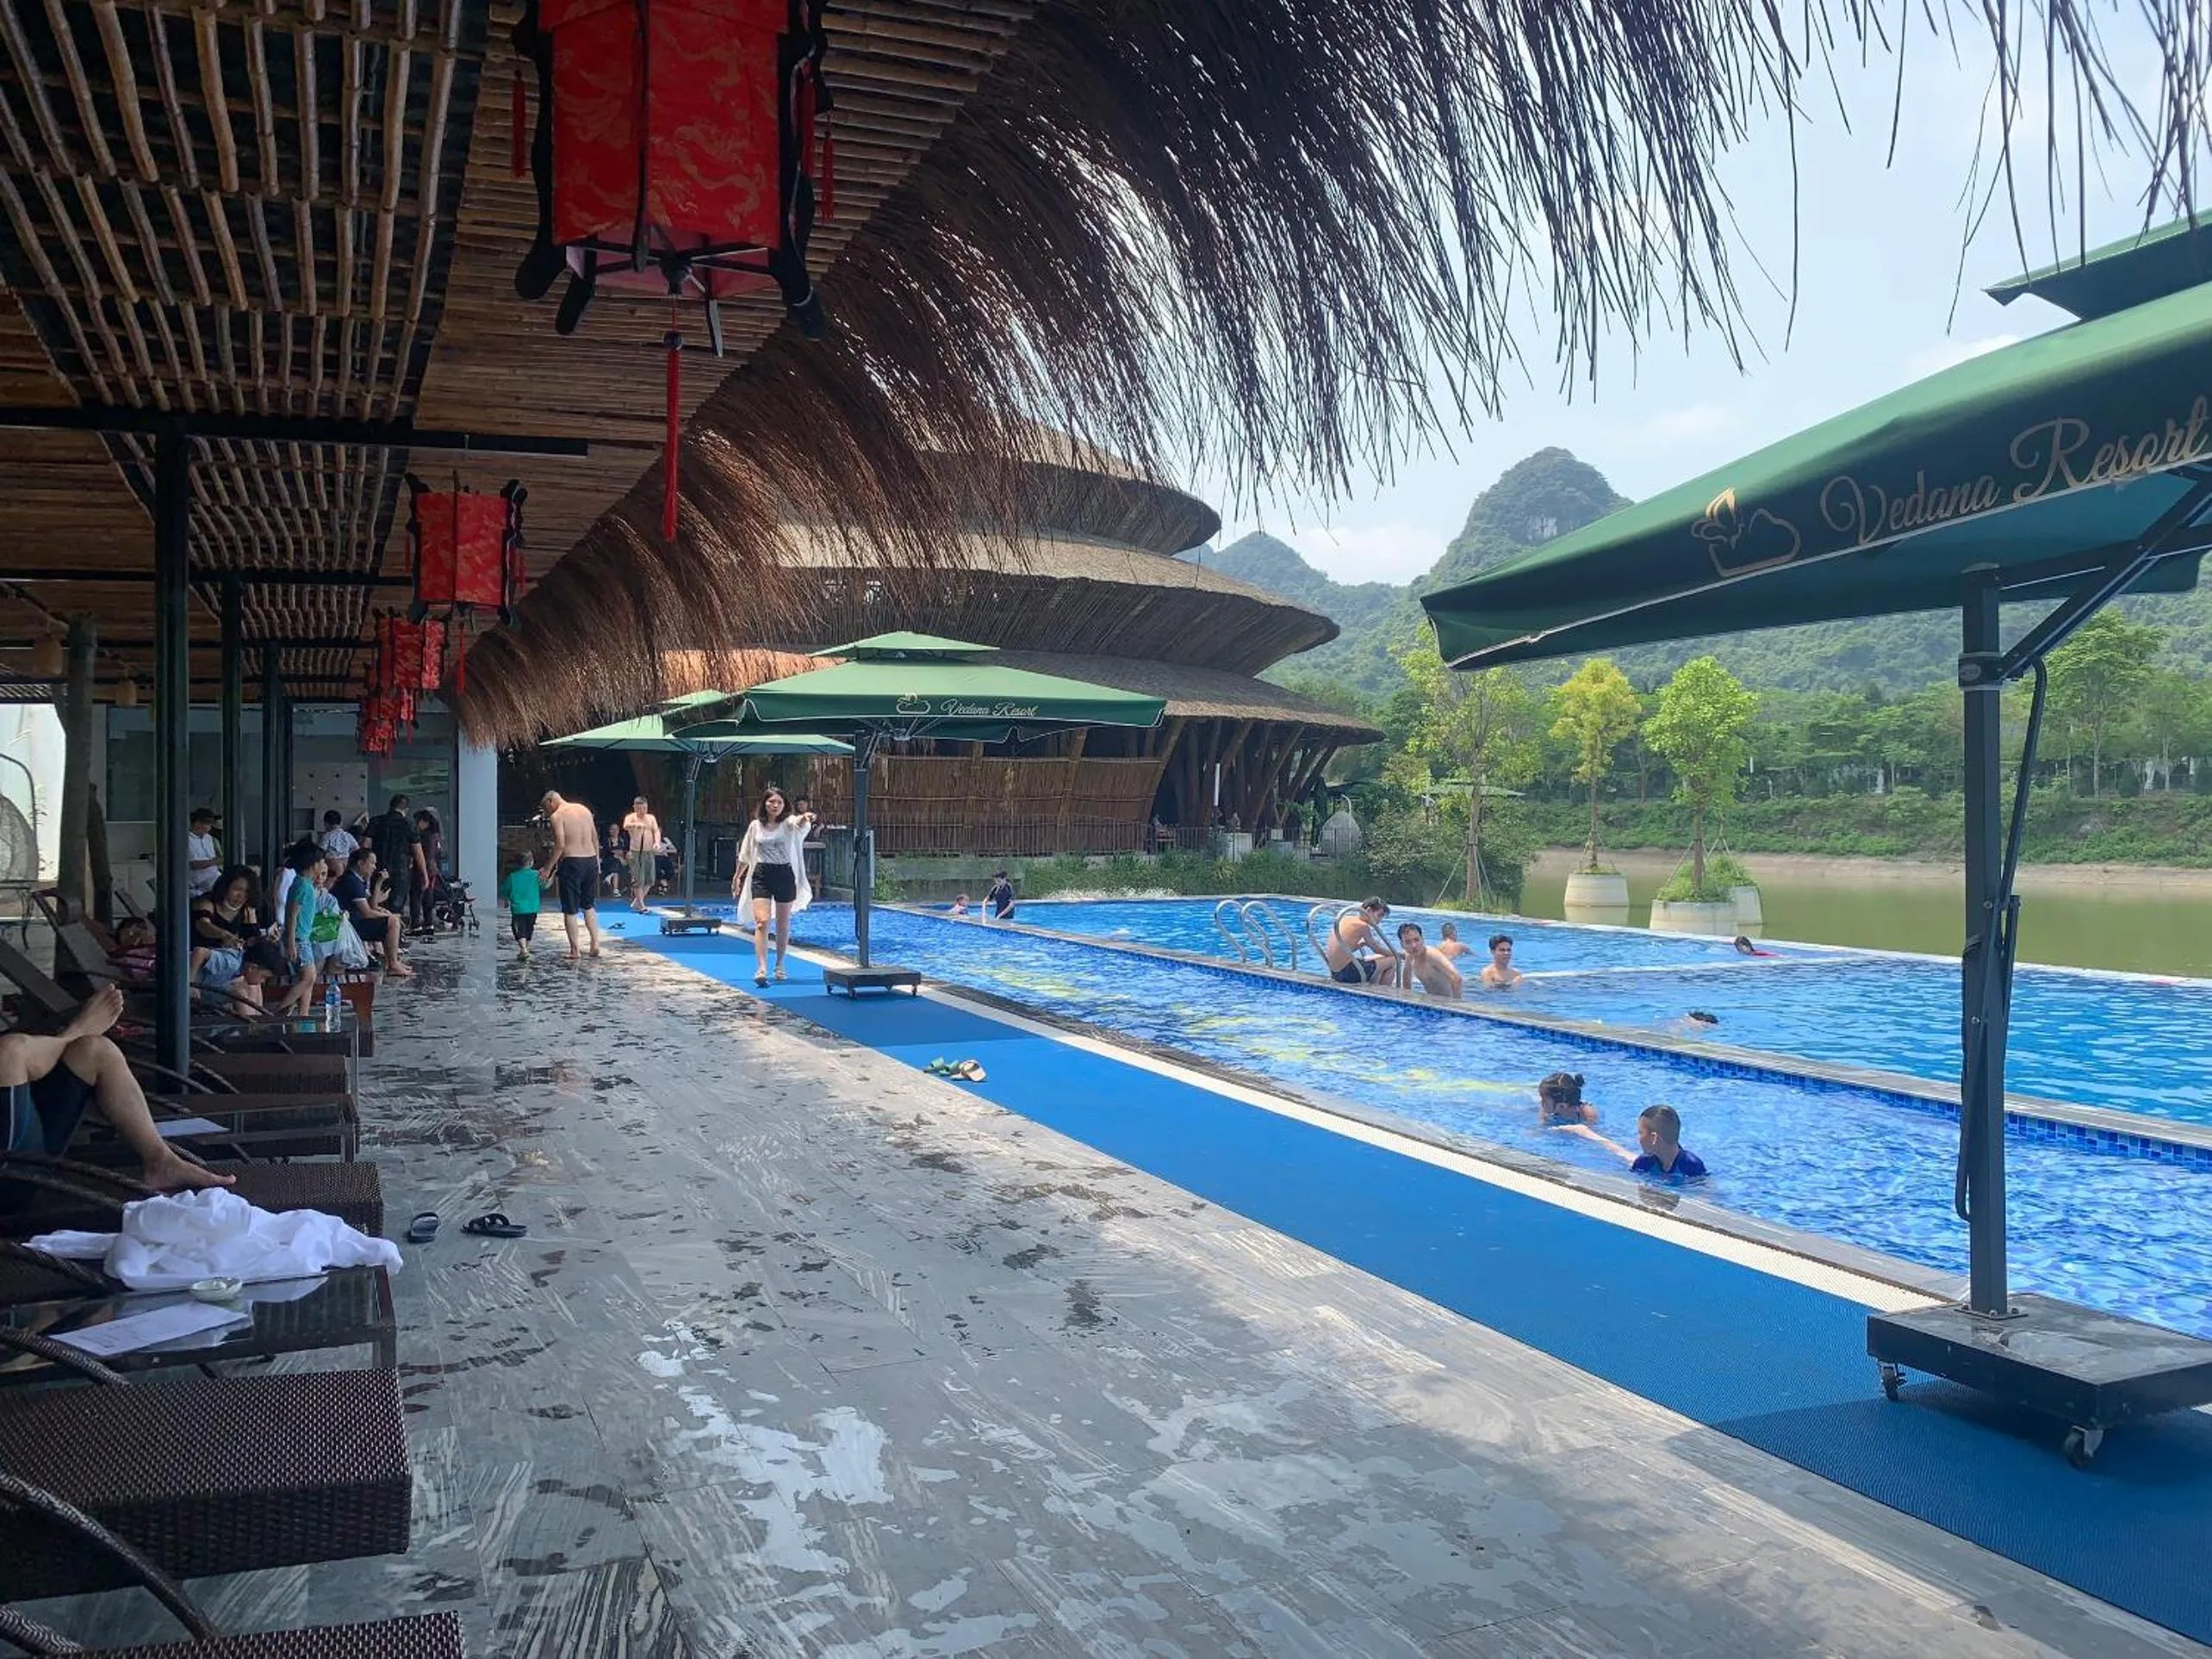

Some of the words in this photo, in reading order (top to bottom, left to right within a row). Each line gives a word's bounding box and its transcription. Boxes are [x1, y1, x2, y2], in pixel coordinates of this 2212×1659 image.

[1819, 470, 2001, 545] Vedana
[2010, 395, 2209, 503] Resort
[940, 698, 989, 716] Vedana
[992, 701, 1039, 717] Resort
